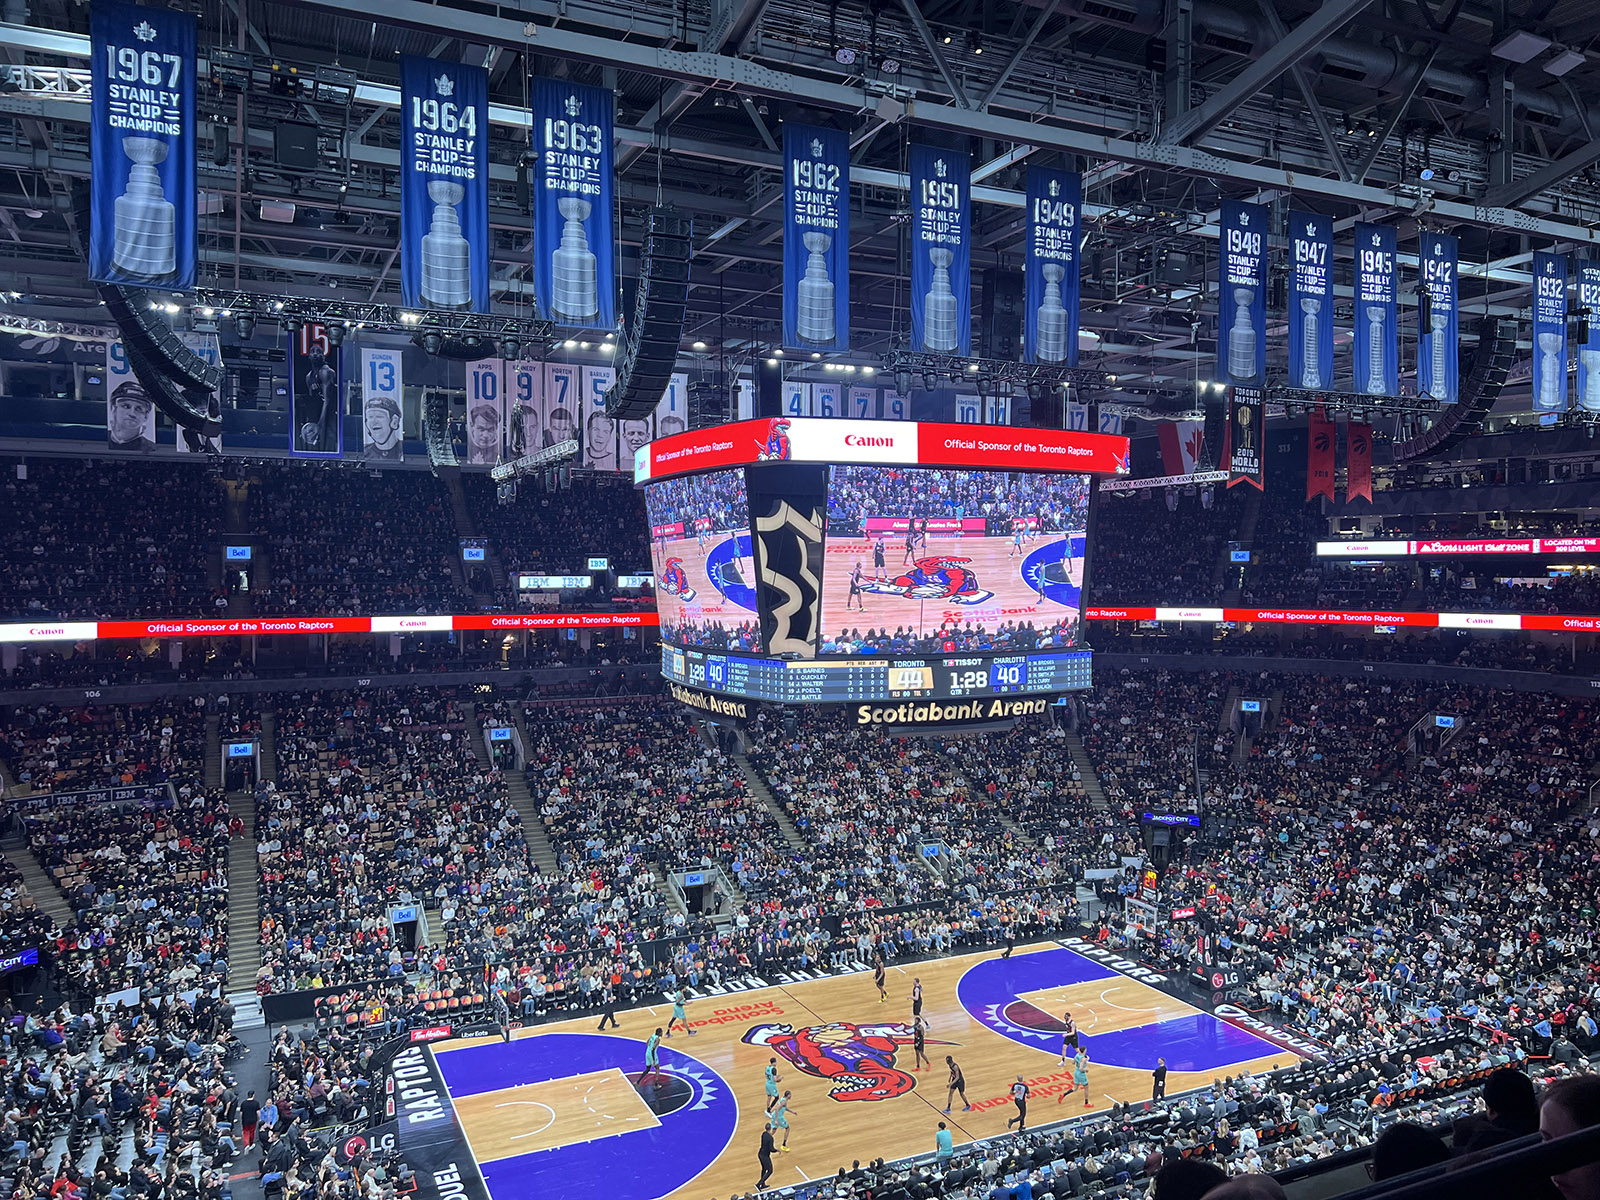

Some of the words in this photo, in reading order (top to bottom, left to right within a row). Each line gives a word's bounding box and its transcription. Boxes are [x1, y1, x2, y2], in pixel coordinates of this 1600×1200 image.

[106, 44, 181, 88] 1967
[108, 83, 181, 107] STANLEY
[130, 101, 161, 119] CUP
[412, 96, 477, 137] 1964
[108, 115, 181, 136] CHAMPIONS
[415, 132, 474, 153] STANLEY
[544, 117, 602, 155] 1963
[432, 149, 459, 164] CUP
[545, 152, 600, 171] STANLEY
[415, 160, 476, 180] CHAMPIONS
[562, 168, 586, 181] CUP
[793, 159, 840, 192] 1962
[545, 177, 601, 195] CHAMPIONS
[794, 190, 838, 205] STANLEY
[921, 178, 959, 209] 1951
[807, 205, 827, 216] CUP
[920, 207, 961, 223] STANLEY
[1033, 198, 1075, 227] 1949
[794, 214, 839, 229] CHAMPIONS
[933, 220, 949, 233] CUP
[921, 231, 961, 245] CHAMPIONS
[1034, 225, 1072, 240] STANLEY
[1045, 238, 1062, 250] CUP
[1227, 228, 1261, 255] 1948
[1034, 248, 1072, 261] CHAMPIONS
[1295, 239, 1327, 265] 1947
[1228, 254, 1259, 268] STANLEY
[1360, 249, 1391, 274] 1945
[1236, 265, 1250, 276] CUP
[1296, 264, 1326, 277] STANLEY
[1424, 258, 1452, 282] 1942
[1227, 273, 1259, 287] CHAMPIONS
[1304, 275, 1317, 286] CUP
[1537, 276, 1563, 298] 1932
[1369, 283, 1383, 294] CUP
[1433, 293, 1445, 302] CUP
[1538, 298, 1562, 309] STANLEY
[1545, 307, 1556, 315] CUP
[301, 323, 330, 357] 15
[369, 361, 395, 391] 13
[551, 367, 573, 375] HORTON
[473, 371, 497, 401] 10
[517, 372, 532, 401] 9
[554, 375, 569, 404] 7
[592, 378, 608, 407] 5
[789, 393, 802, 416] 4
[821, 394, 833, 417] 6
[856, 398, 869, 418] 7
[891, 400, 904, 419] 9
[960, 406, 976, 422] 10
[1070, 411, 1084, 431] 17
[1100, 412, 1121, 435] 27
[693, 444, 712, 455] Toronto
[712, 441, 733, 452] Raptors
[844, 434, 894, 448] Canon
[944, 439, 977, 450] Official
[977, 440, 1012, 453] Sponsor
[1013, 442, 1023, 452] of
[1022, 443, 1037, 453] the
[1038, 444, 1067, 455] Toronto
[1067, 445, 1094, 457] Raptors
[1237, 448, 1254, 457] 2019
[1231, 456, 1259, 467] WORLD
[1231, 466, 1259, 474] CHAMPIONS
[232, 549, 246, 557] Bell
[1458, 543, 1483, 552] LIGHT
[1506, 543, 1529, 552] ZONE
[590, 560, 606, 568] IBM
[527, 576, 550, 587] IBM
[562, 576, 585, 587] IBM
[943, 606, 1037, 618] Scotiabank
[1100, 609, 1127, 618] Raptors
[1257, 611, 1284, 620] Official
[1286, 611, 1318, 621] Sponsor
[1318, 612, 1328, 621] of
[1328, 612, 1341, 622] the
[1343, 612, 1372, 622] Toronto
[1373, 613, 1405, 624] Raptors
[147, 622, 184, 633] Official
[186, 621, 227, 633] Sponsor
[228, 620, 240, 632] of
[240, 620, 258, 632] the
[259, 619, 296, 631] Toronto
[298, 619, 334, 631] Raptors
[399, 619, 427, 628] Canon
[491, 616, 521, 627] Official
[522, 615, 555, 627] Sponsor
[556, 615, 566, 625] of
[566, 615, 580, 625] the
[581, 614, 611, 625] Toronto
[612, 614, 641, 625] Raptors
[1466, 616, 1494, 625] Canon
[1563, 618, 1593, 629] Official
[29, 627, 65, 636] Canon
[893, 660, 925, 668] TORONTO
[953, 658, 983, 667] TISSOT
[993, 656, 1026, 665] CHARLOTTE
[689, 662, 706, 682] 1:28
[709, 664, 723, 682] 40
[997, 667, 1020, 685] 40
[357, 679, 371, 687] 107
[897, 669, 924, 690] 44
[950, 671, 987, 690] 1:28
[84, 690, 101, 699] 106
[710, 695, 747, 719] Arena
[857, 700, 983, 725] Scotiabank
[988, 698, 1047, 718] Arena
[1245, 702, 1256, 711] Bell
[495, 729, 509, 738] Bell
[234, 745, 249, 755] Bell
[57, 795, 77, 805] IBM
[115, 789, 136, 800] IBM
[689, 875, 701, 884] Bell
[398, 909, 412, 920] Bell
[4, 955, 22, 967] CITY
[839, 960, 872, 973] WE
[1059, 936, 1168, 985] RAPTORS
[779, 967, 832, 984] THE
[1224, 972, 1239, 985] LG
[713, 1001, 774, 1016] Arena
[414, 1031, 426, 1040] Tim
[461, 1031, 475, 1039] Uber
[474, 1030, 489, 1038] Eats
[370, 1133, 395, 1152] LG
